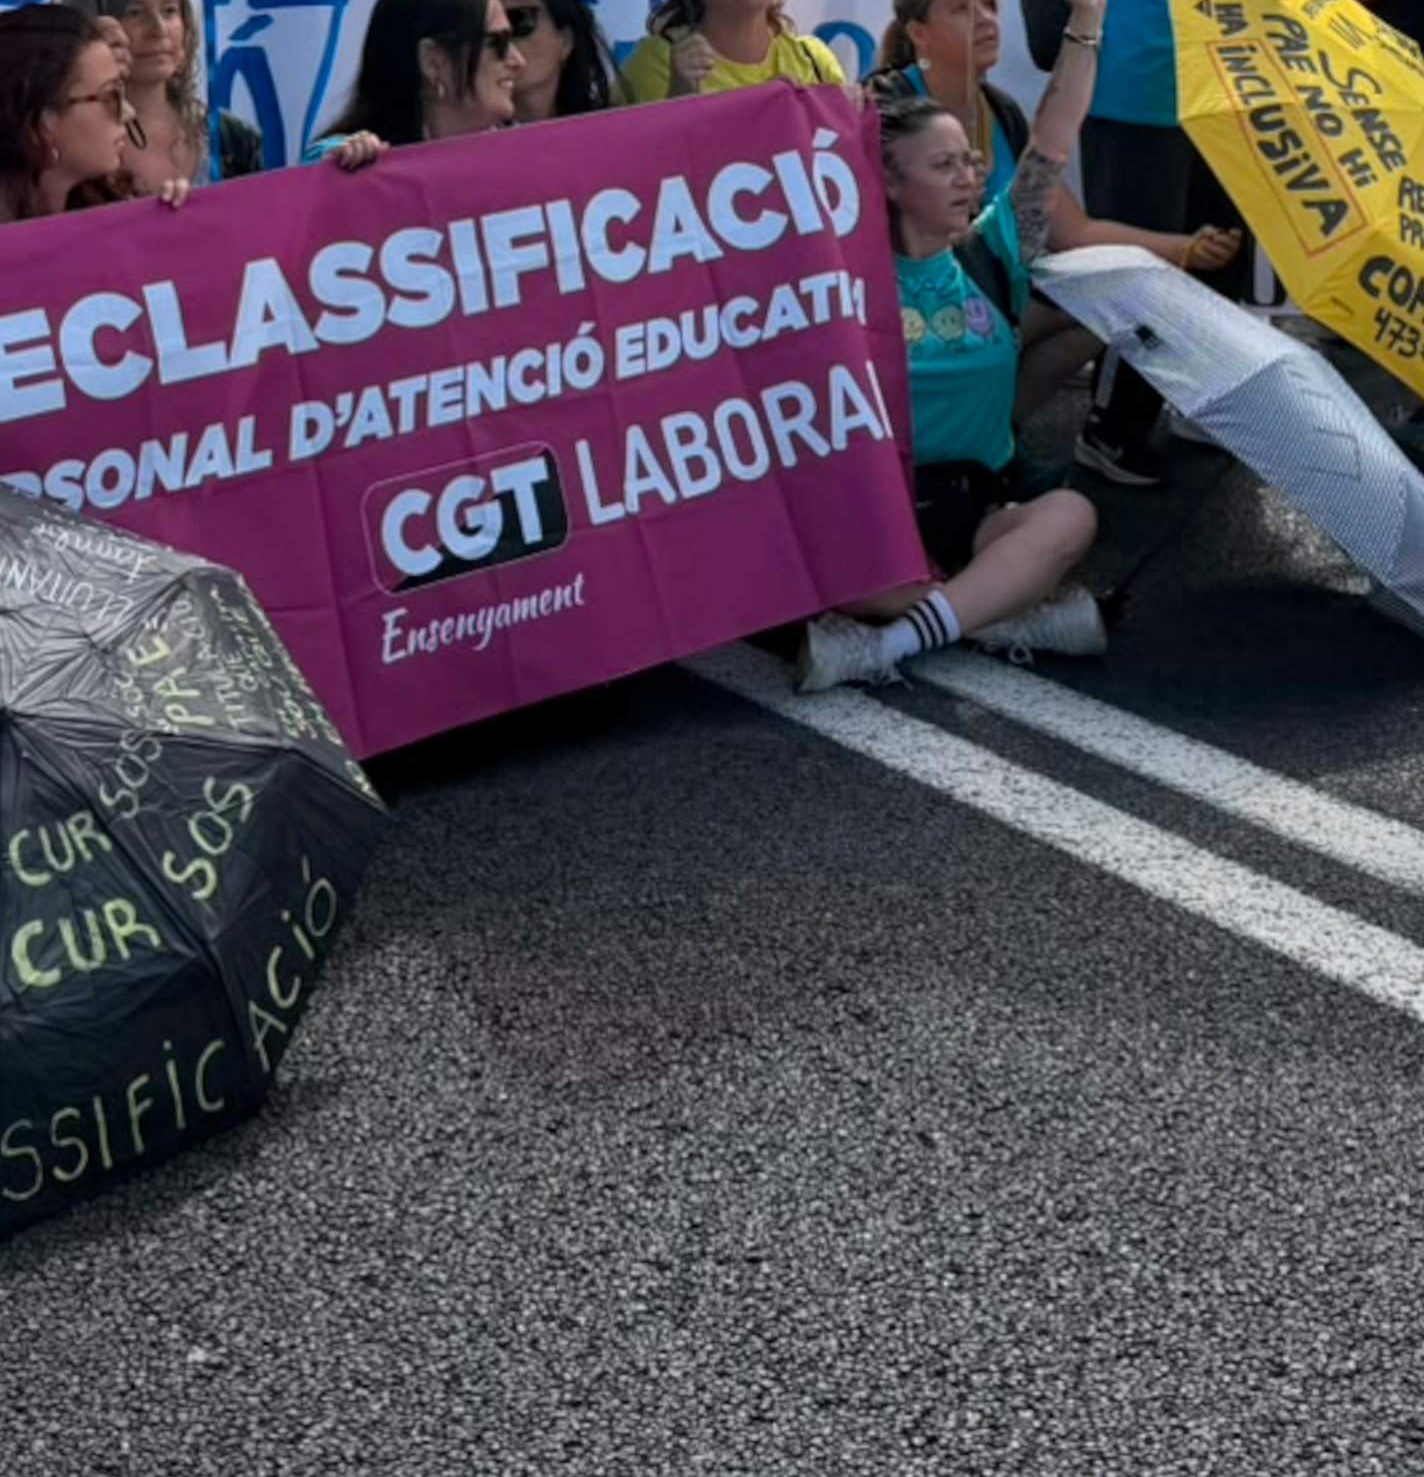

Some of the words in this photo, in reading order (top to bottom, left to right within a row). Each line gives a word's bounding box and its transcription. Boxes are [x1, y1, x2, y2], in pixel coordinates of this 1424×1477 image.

[288, 322, 606, 463] D'ATENCIÓ
[381, 456, 550, 577] CGT
[381, 573, 586, 666] Ensenyament
